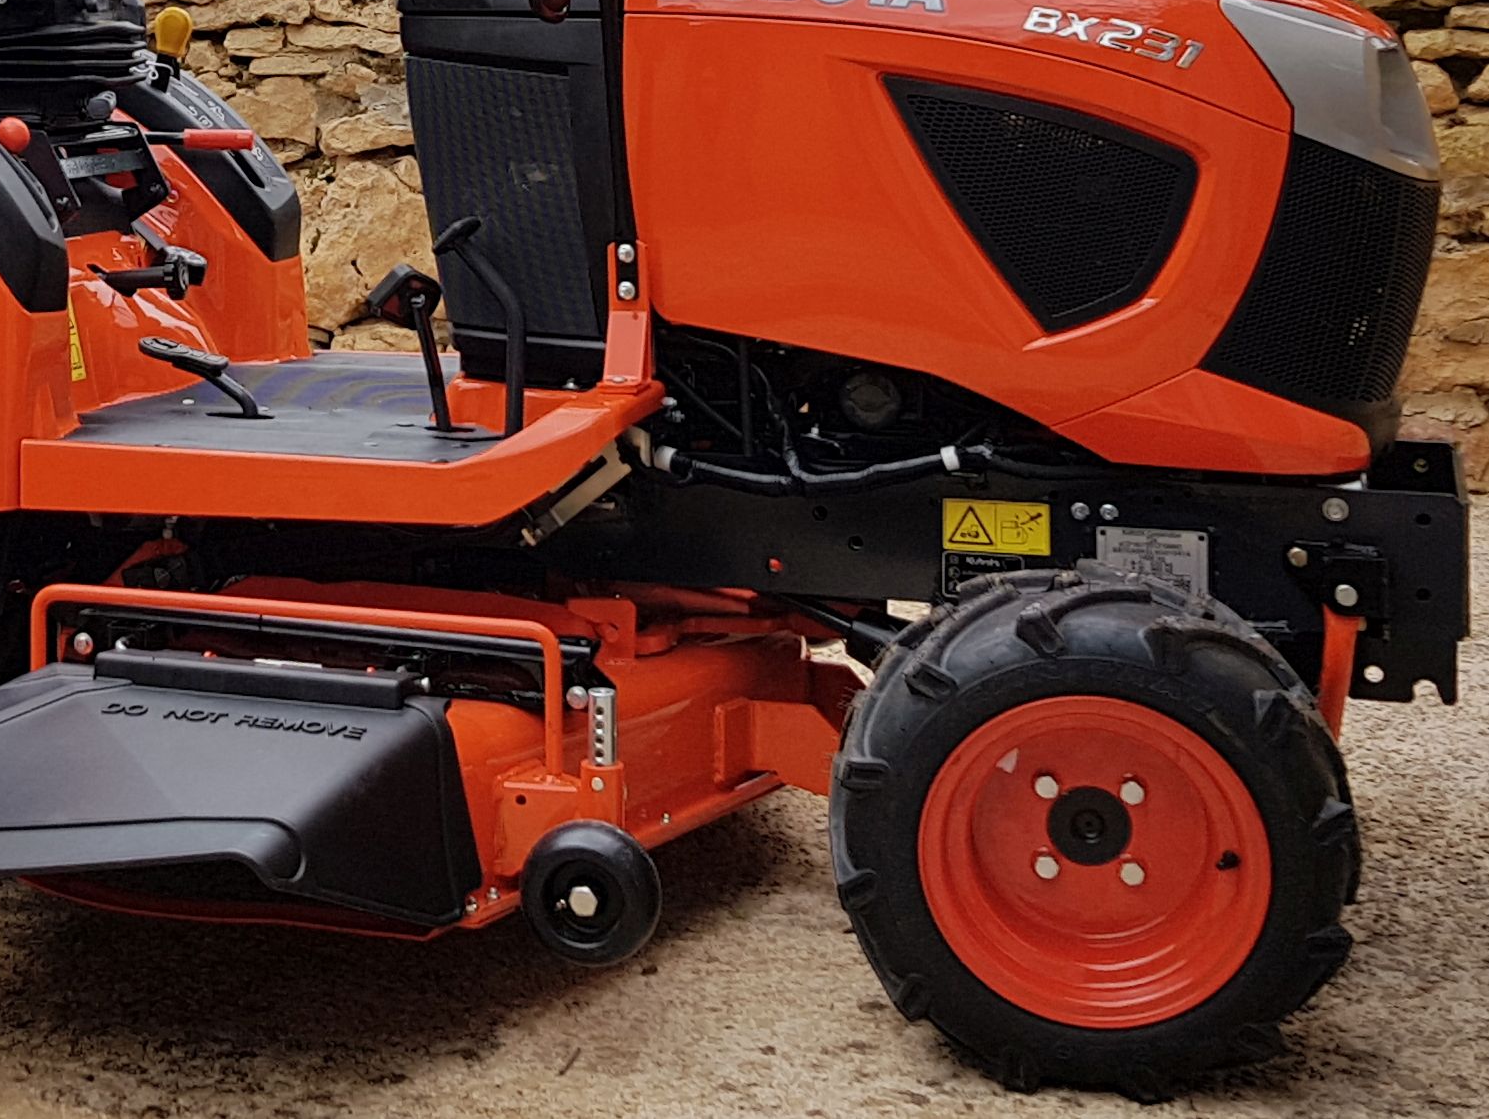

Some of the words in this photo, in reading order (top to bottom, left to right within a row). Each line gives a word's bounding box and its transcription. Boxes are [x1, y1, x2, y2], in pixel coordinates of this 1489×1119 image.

[1022, 6, 1205, 70] BX231
[101, 702, 149, 717] DO
[162, 707, 229, 725] NOT
[234, 713, 369, 741] REMOVE
